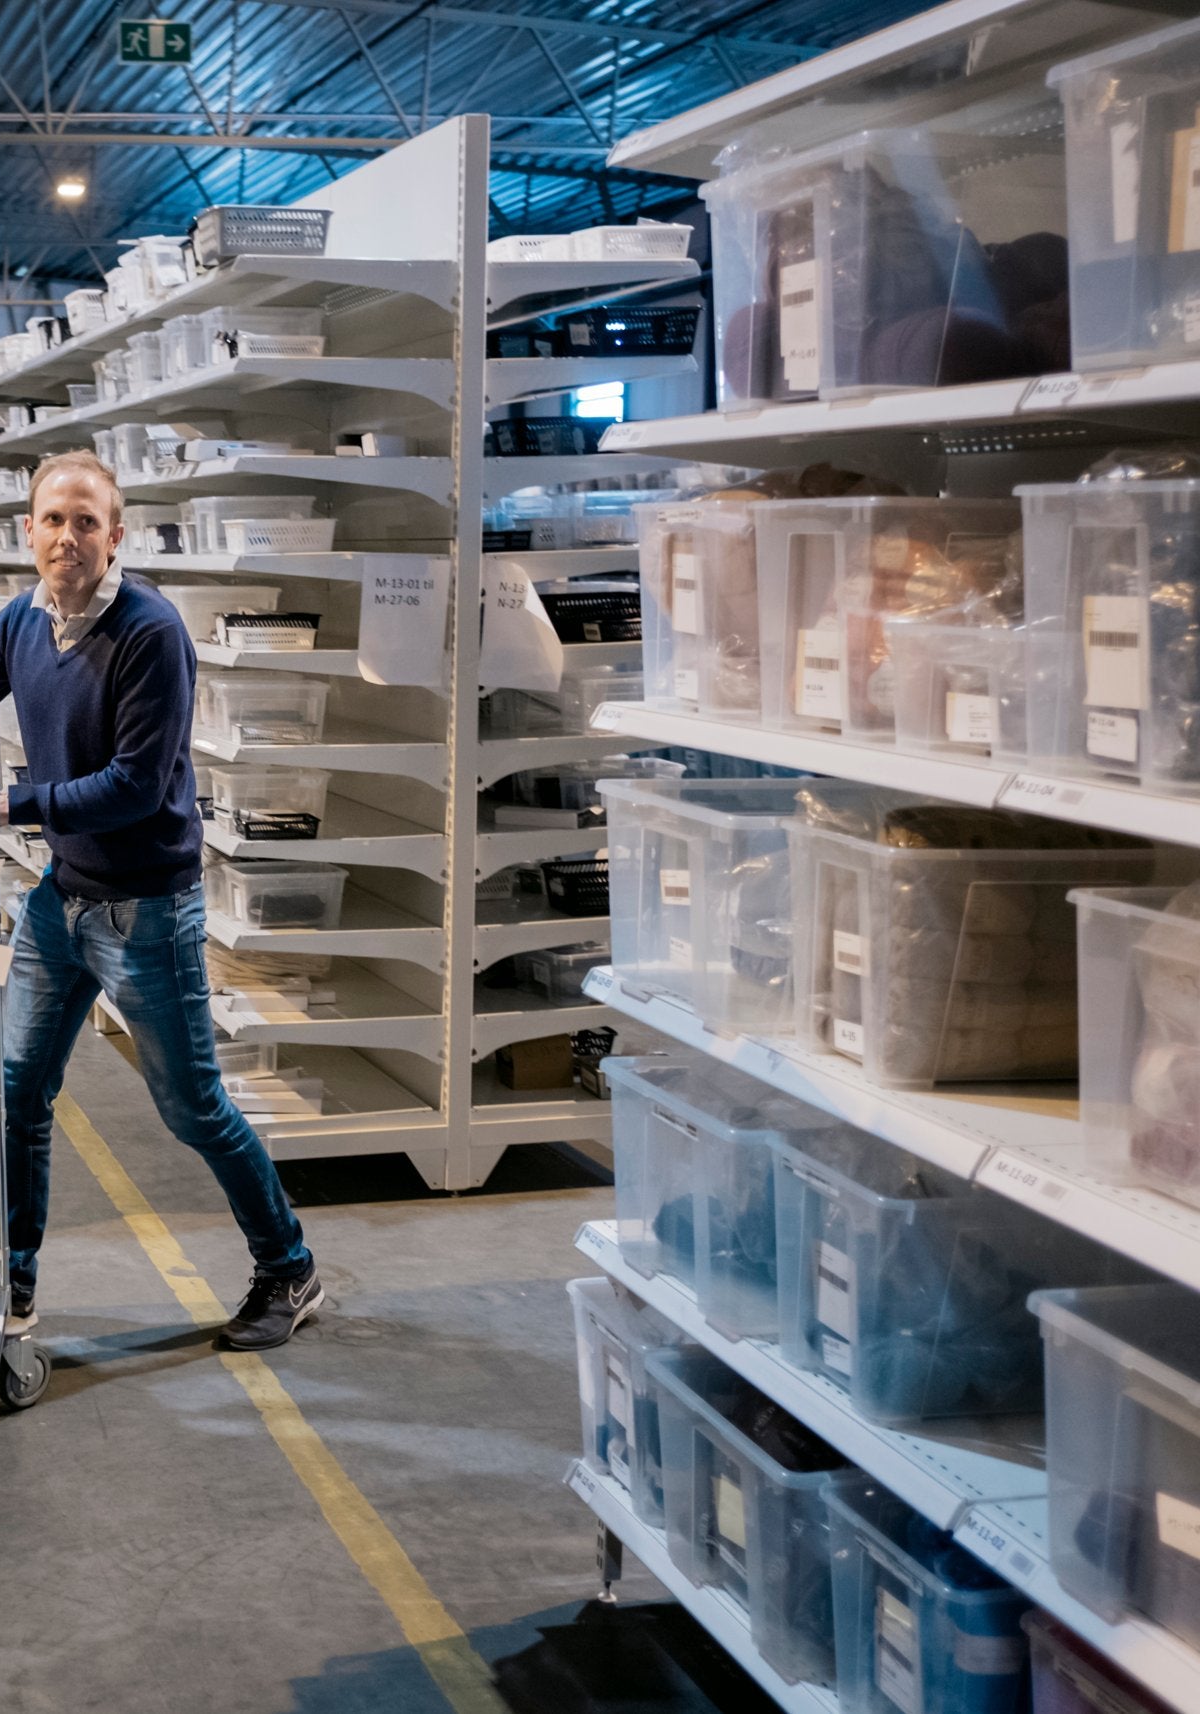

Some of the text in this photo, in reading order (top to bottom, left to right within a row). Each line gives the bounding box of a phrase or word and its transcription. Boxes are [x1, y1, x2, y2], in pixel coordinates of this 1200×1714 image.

[375, 577, 434, 590] M-13-01 til
[374, 595, 420, 606] M-27-06
